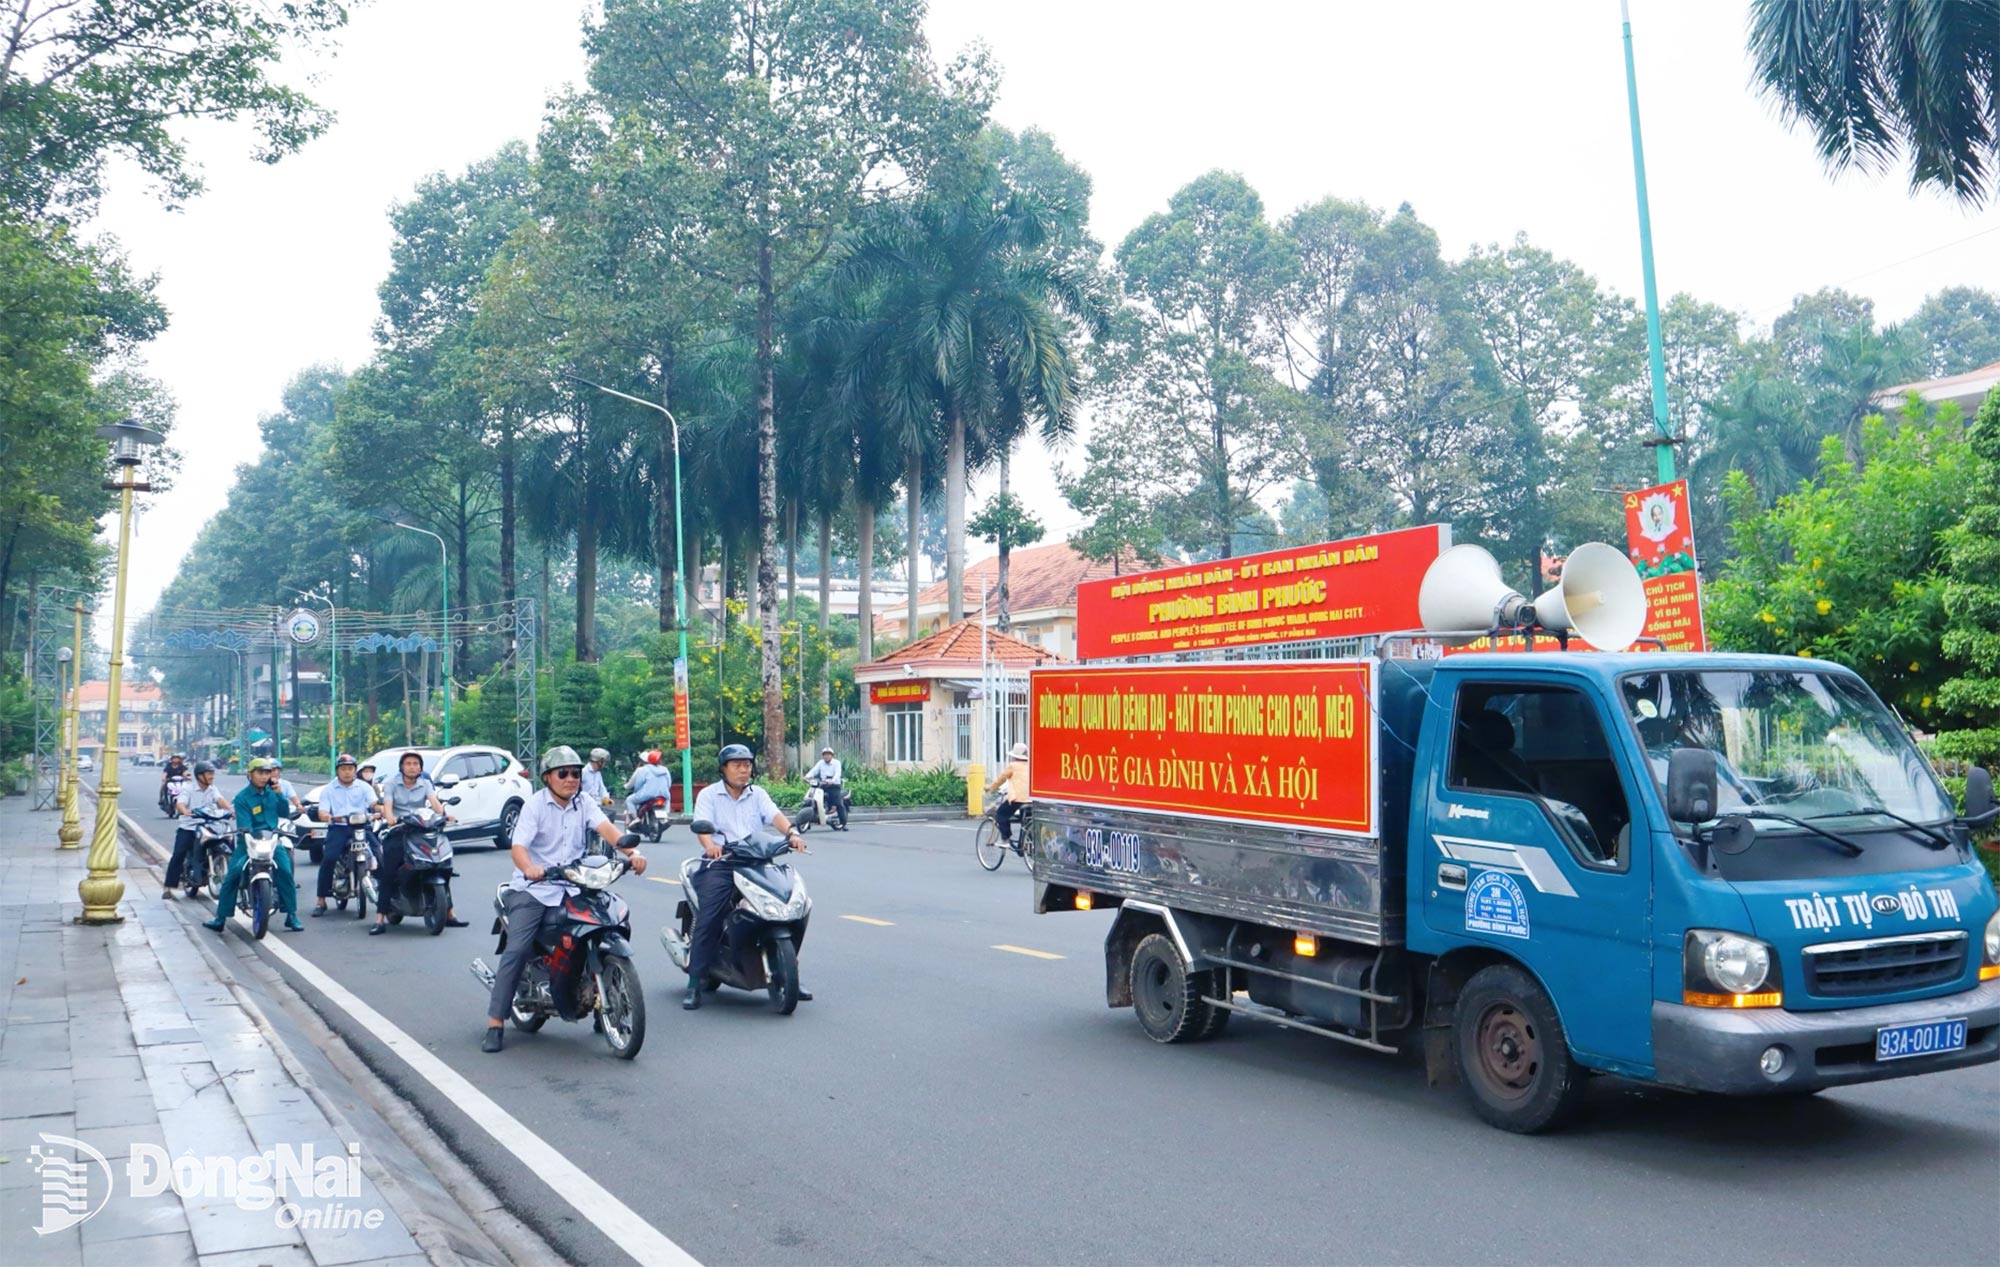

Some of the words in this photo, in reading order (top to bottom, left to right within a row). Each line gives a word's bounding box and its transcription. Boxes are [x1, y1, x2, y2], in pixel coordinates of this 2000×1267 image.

[1111, 582, 1131, 600] HỘI
[1132, 577, 1164, 595] ĐỒNG
[1166, 572, 1202, 590] NHÂN
[1204, 567, 1233, 585] DÂN
[1262, 558, 1294, 576] BAN
[1296, 550, 1340, 571] NHÂN
[1344, 544, 1378, 564] DÂN
[1148, 594, 1214, 623] PHƯỜNG
[1217, 588, 1258, 616] BÌNH
[1262, 576, 1326, 610] PHƯỚC
[1646, 584, 1663, 596] CHỦ
[1666, 581, 1685, 593] TỊCH
[1654, 596, 1668, 606] CHÍ
[1671, 592, 1694, 604] MINH
[1344, 607, 1363, 619] CITY
[1648, 621, 1671, 632] SỐNG
[1040, 687, 1061, 728] ĐỪNG
[1063, 682, 1080, 730] CHỦ
[1082, 694, 1104, 734] QUAN
[1106, 686, 1121, 730] VỚI
[1123, 686, 1148, 740] BỆNH
[1150, 694, 1166, 740] DẠI
[1176, 686, 1195, 732] HÃY
[1198, 685, 1223, 734] TIÊM
[1226, 684, 1263, 736] PHÒNG
[1267, 694, 1290, 737] CHO
[1294, 685, 1322, 743] CHÓ,
[1326, 684, 1354, 739] MÈO
[1061, 744, 1093, 782] BẢO
[1098, 746, 1119, 792] VỆ
[1124, 756, 1154, 786] GIA
[1159, 748, 1204, 790] ĐÌNH
[1210, 752, 1238, 794] VÀ
[1244, 755, 1272, 797] XÃ
[1279, 756, 1318, 810] HỘI
[1473, 876, 1486, 891] TÂM
[1785, 892, 1841, 932] TRẬT
[1842, 891, 1873, 929] TỰ
[1898, 884, 1928, 921] ĐÔ
[1926, 889, 1960, 922] THỊ
[1876, 898, 1897, 912] KIA
[1880, 1023, 1963, 1055] 93A-001.19
